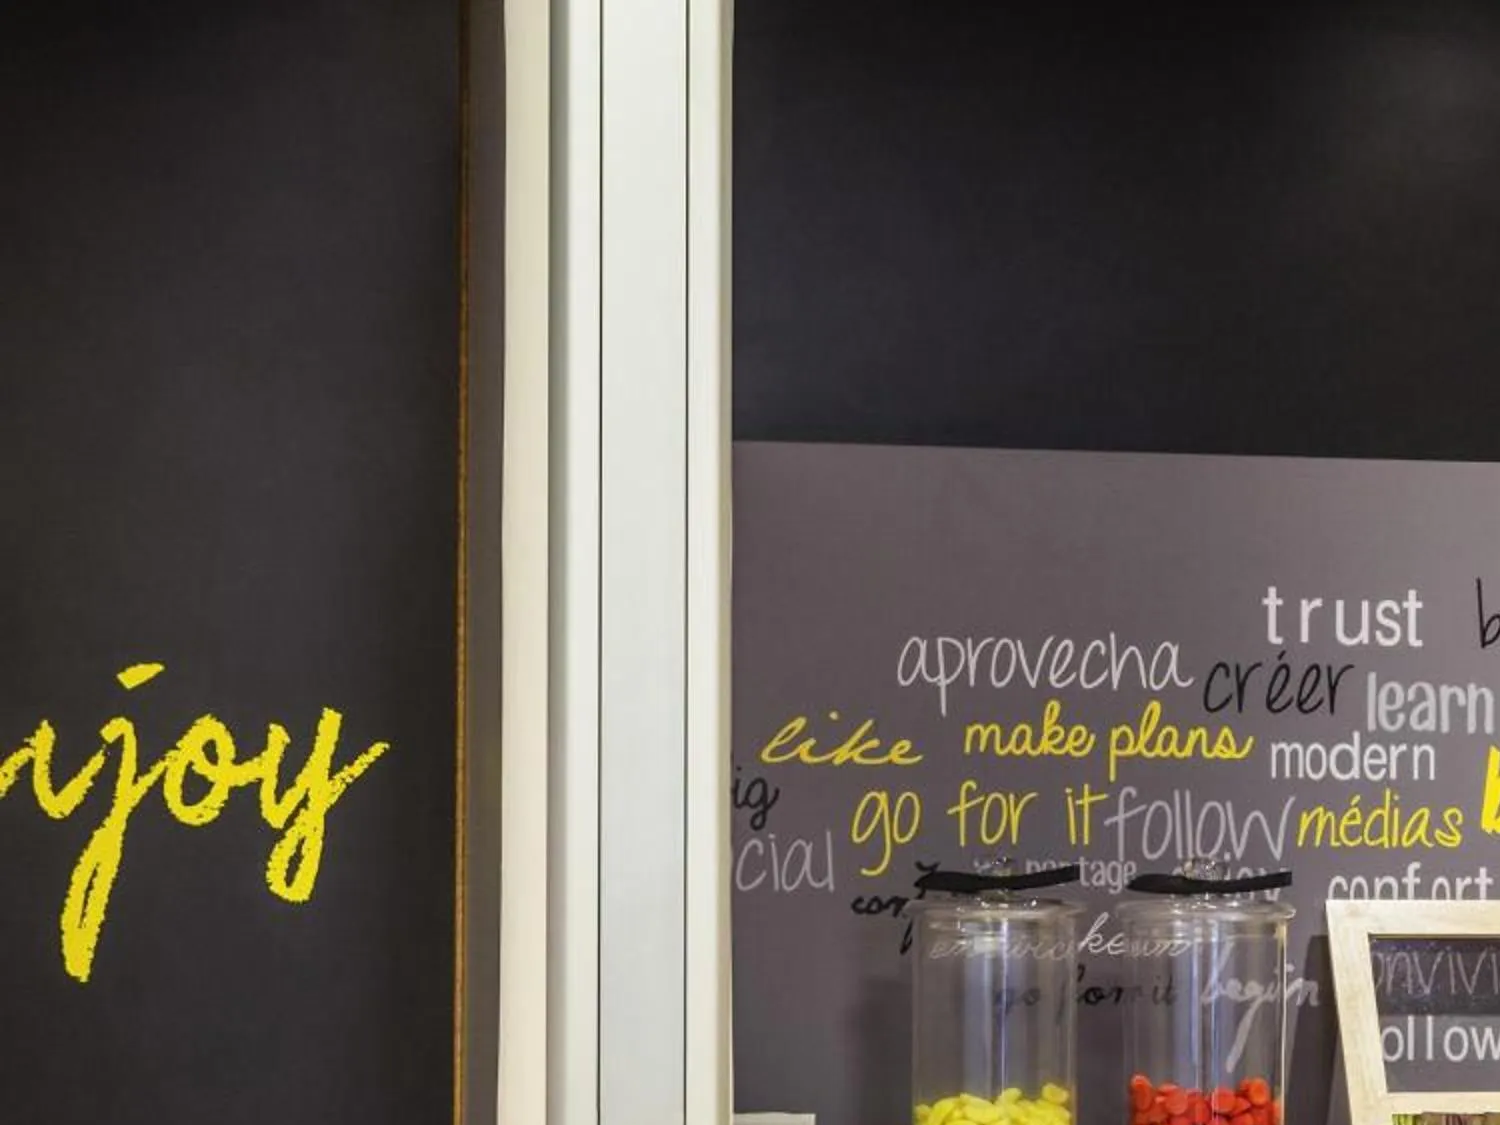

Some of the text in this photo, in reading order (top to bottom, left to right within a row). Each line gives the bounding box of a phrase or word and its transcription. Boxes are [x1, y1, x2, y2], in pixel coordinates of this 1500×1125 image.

[1263, 585, 1423, 647] trust
[897, 632, 1196, 717] aprovecha
[1203, 651, 1354, 714] créer
[1367, 672, 1494, 734] learn
[760, 709, 924, 766] like
[963, 700, 1254, 782] make plans
[1271, 732, 1435, 780] modern
[851, 780, 1108, 876] go for it
[1104, 787, 1296, 861] follow
[1297, 788, 1463, 849] médias
